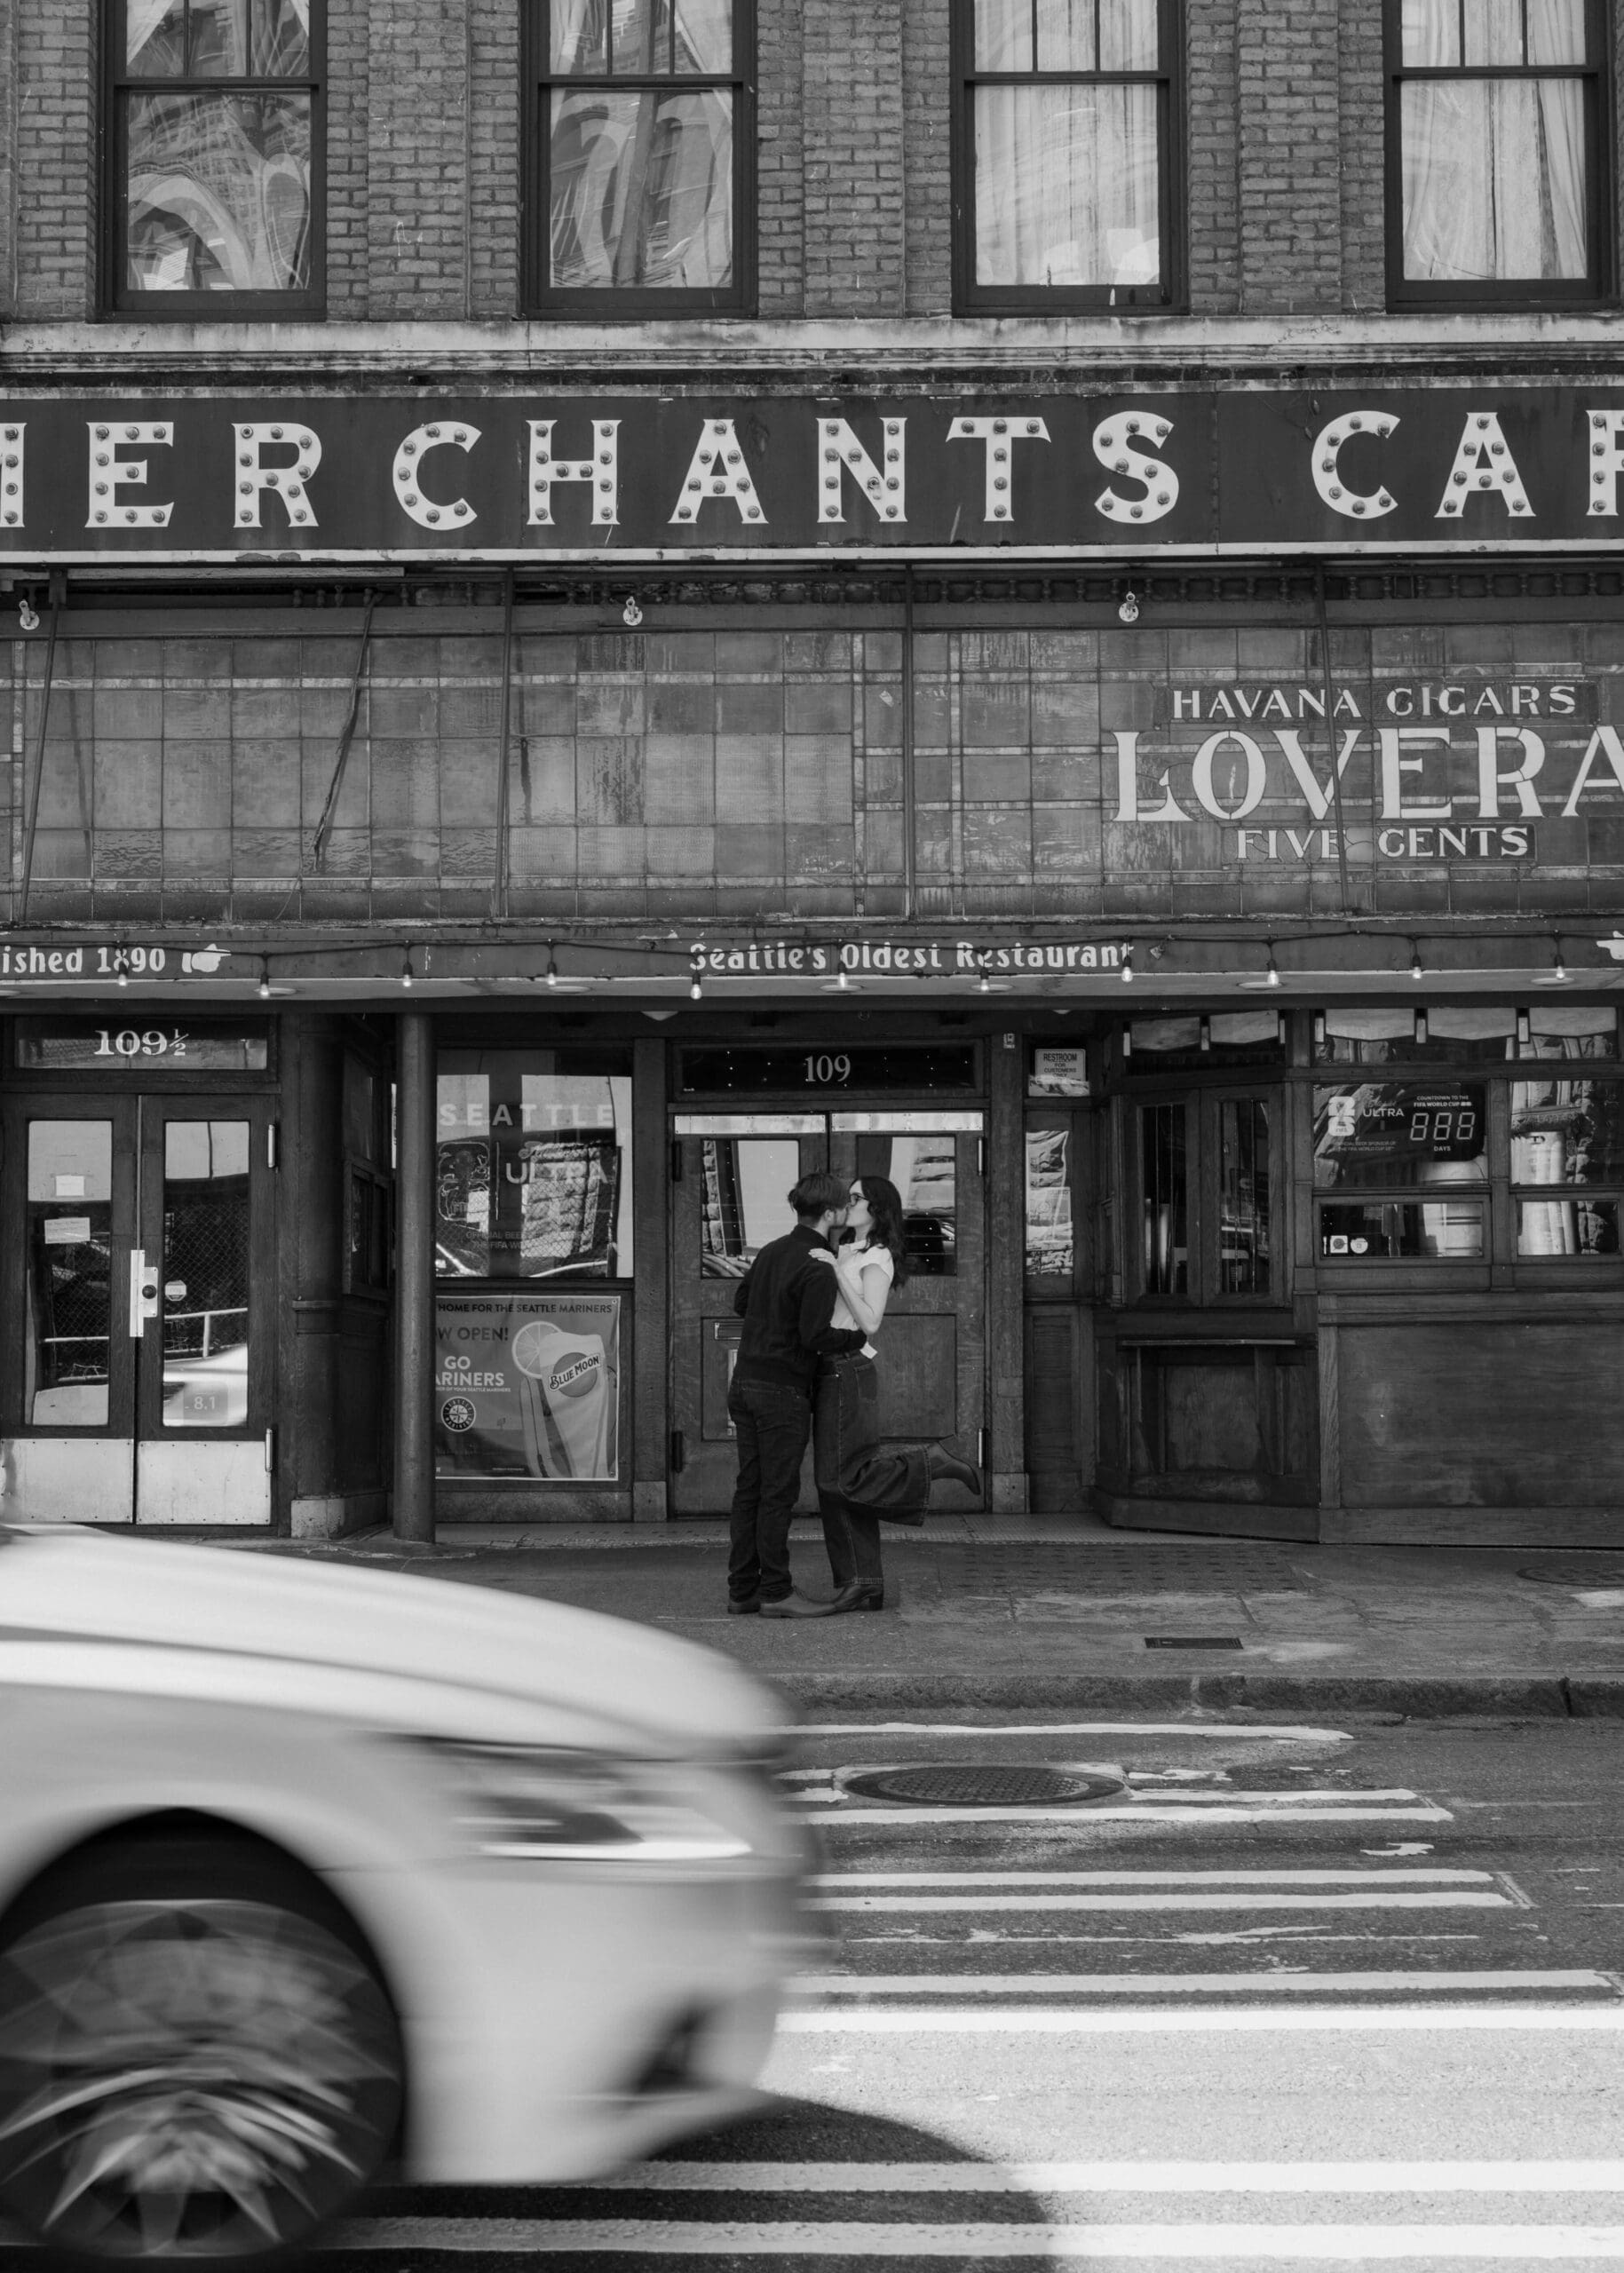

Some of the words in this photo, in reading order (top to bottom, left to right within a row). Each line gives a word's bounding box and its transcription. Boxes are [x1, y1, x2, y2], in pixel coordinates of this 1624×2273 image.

[1173, 687, 1362, 719] HAVANA
[1386, 685, 1577, 717] CIGARS
[1237, 828, 1345, 859] FIVE
[1379, 826, 1529, 859] CENTS
[97, 946, 166, 973] 1890
[689, 941, 827, 971] Seattle's
[839, 943, 943, 970] Oldest
[955, 941, 1136, 969] Restaurant
[804, 1054, 851, 1083] 109
[1043, 1052, 1077, 1062] RESTROOM
[438, 1103, 614, 1127] SEATTLE
[1363, 1107, 1405, 1118] ULTRA
[438, 1303, 470, 1313] HOME
[471, 1303, 493, 1313] FOR
[495, 1303, 514, 1313] THE
[516, 1303, 558, 1314] SEATTLE
[558, 1303, 613, 1314] MARINERS
[456, 1326, 510, 1342] OPEN!
[444, 1355, 471, 1370] GO
[550, 1369, 574, 1390] BLUE
[574, 1355, 599, 1375] MOON
